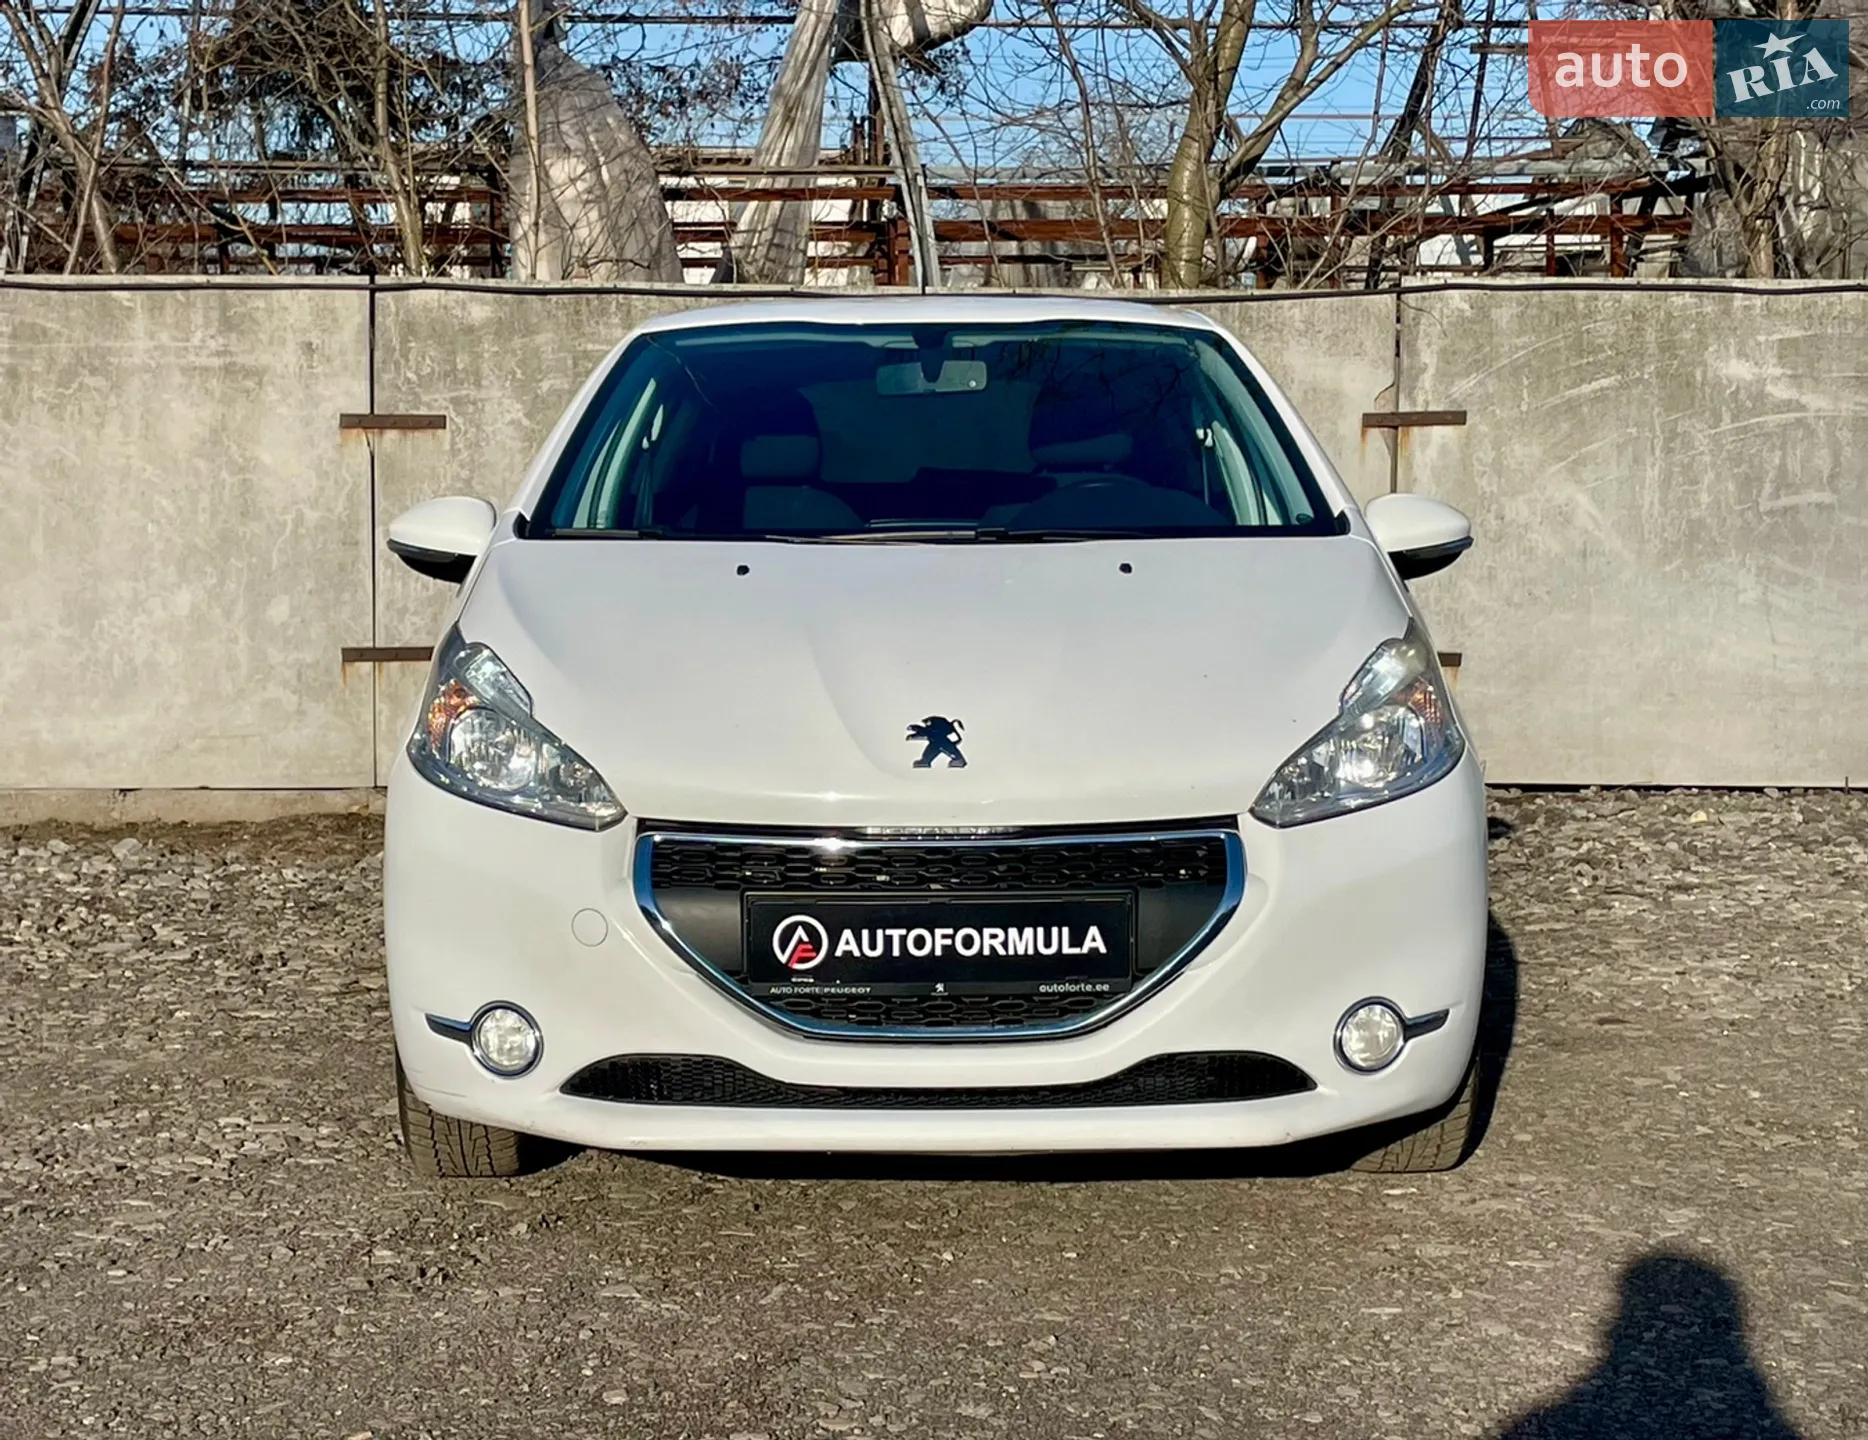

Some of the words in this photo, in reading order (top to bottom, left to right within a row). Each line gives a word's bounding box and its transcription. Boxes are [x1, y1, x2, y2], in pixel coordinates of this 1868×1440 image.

[834, 925, 1107, 958] AUTOFORMULA
[770, 986, 793, 995] AUTO
[794, 986, 820, 995] FORTE
[823, 986, 871, 995] PEUGEOT
[1038, 982, 1110, 993] autoforte.ee
